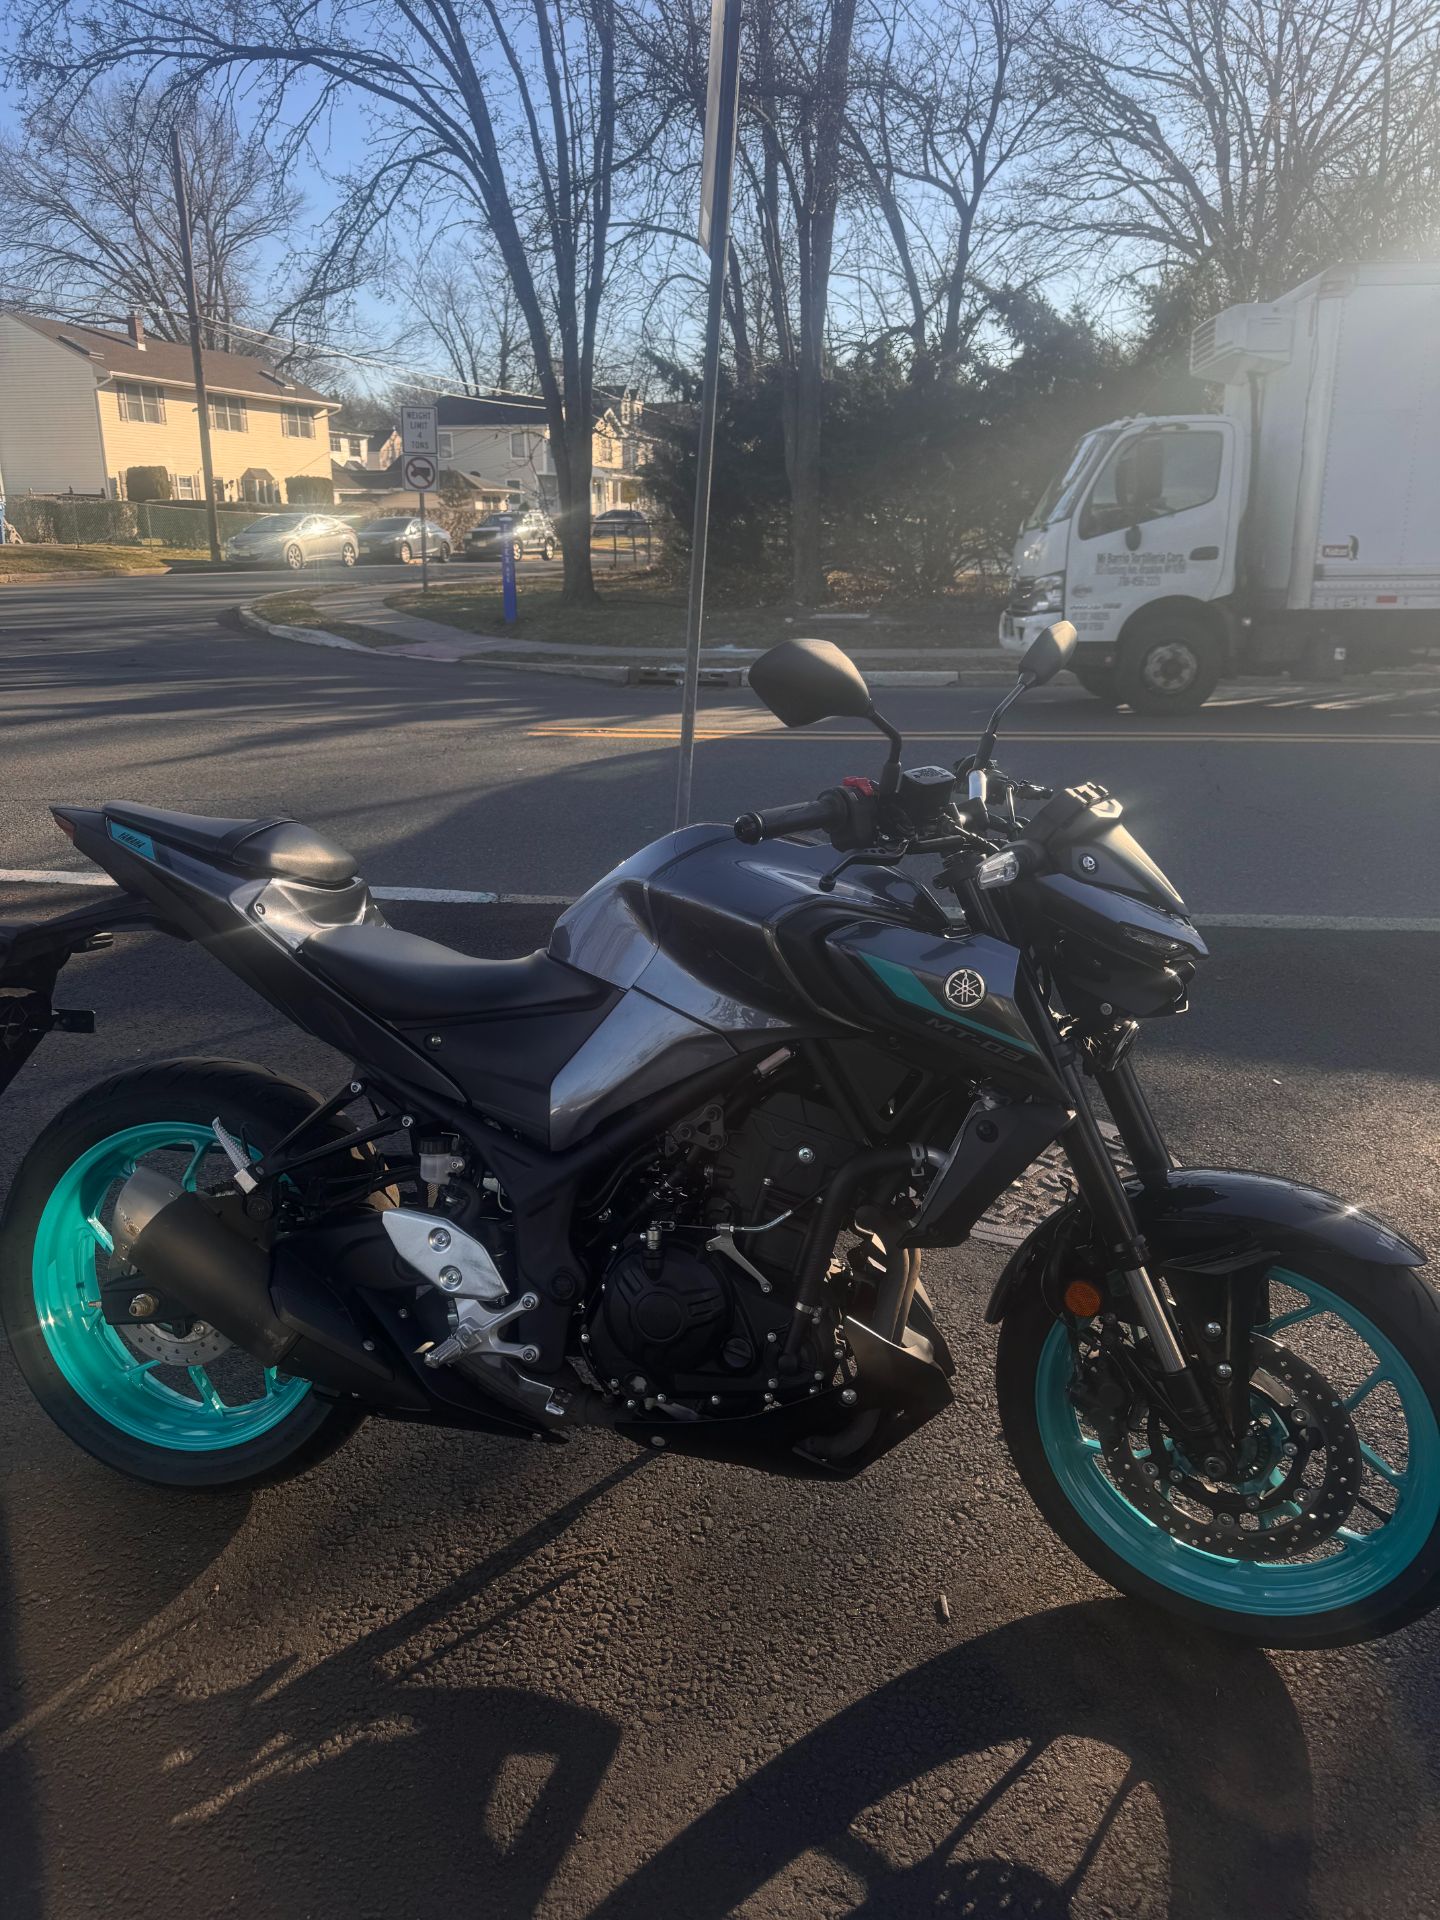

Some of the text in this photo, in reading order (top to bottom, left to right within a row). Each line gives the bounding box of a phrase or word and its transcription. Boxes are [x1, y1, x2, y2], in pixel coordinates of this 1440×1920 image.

[407, 411, 431, 420] WEIGHT
[410, 421, 428, 430] LIMIT
[417, 431, 422, 439] 4
[411, 441, 429, 450] TONS
[926, 1018, 1025, 1061] MT-03
